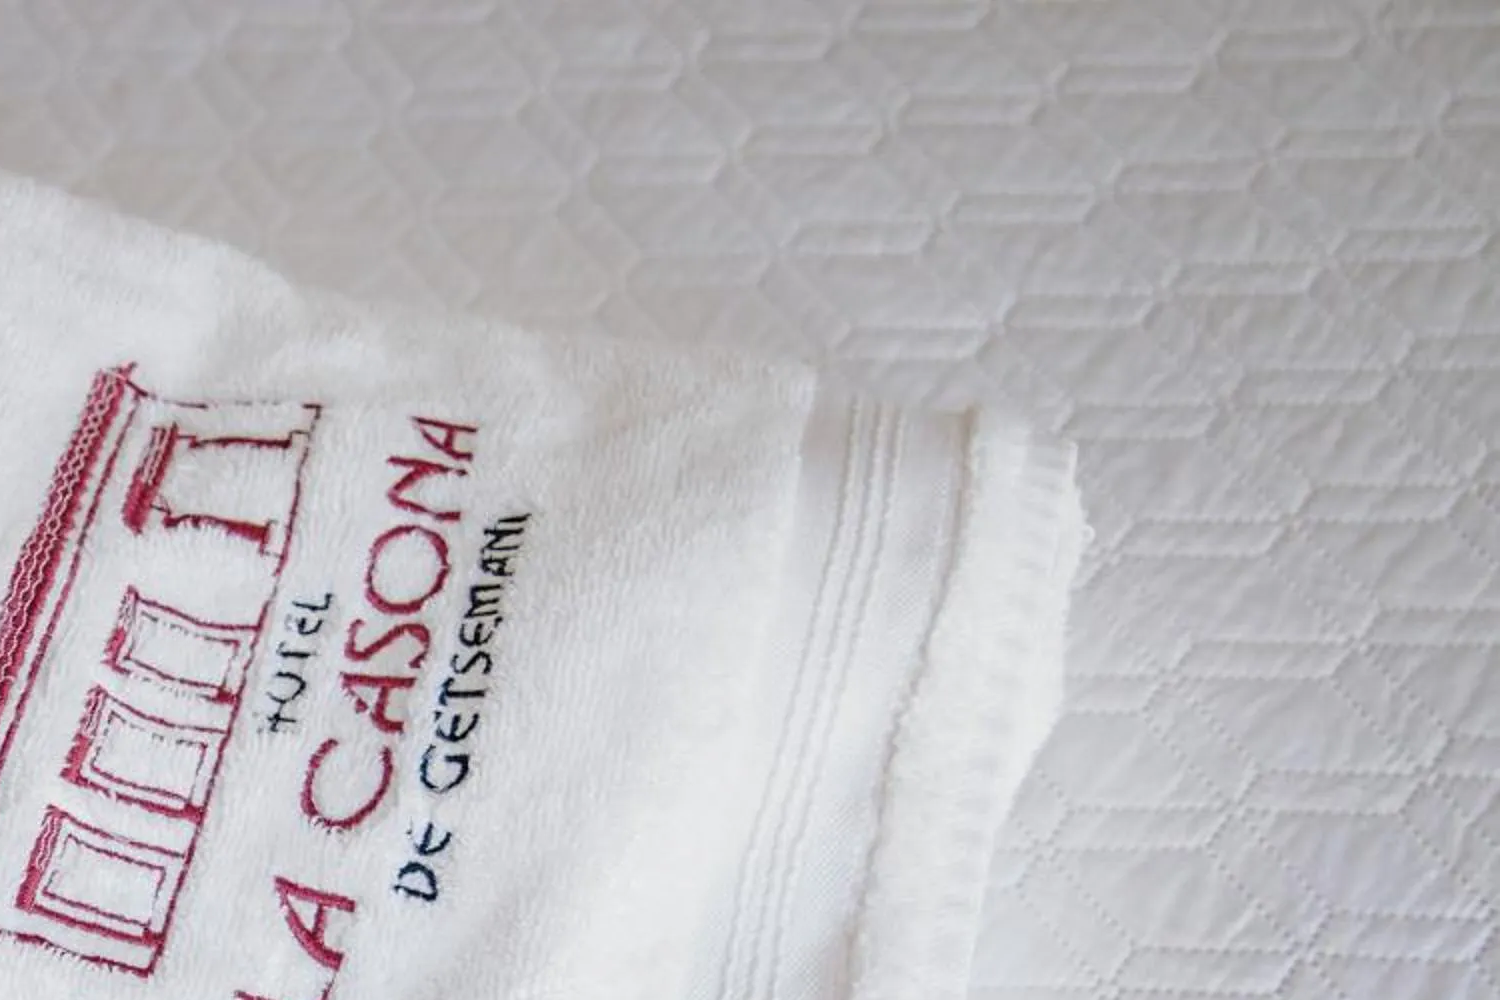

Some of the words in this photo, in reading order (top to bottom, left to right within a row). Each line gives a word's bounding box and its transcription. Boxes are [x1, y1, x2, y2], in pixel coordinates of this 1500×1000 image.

[299, 415, 478, 832] CASONA
[419, 511, 533, 793] GETSEMANI
[393, 821, 453, 901] DE
